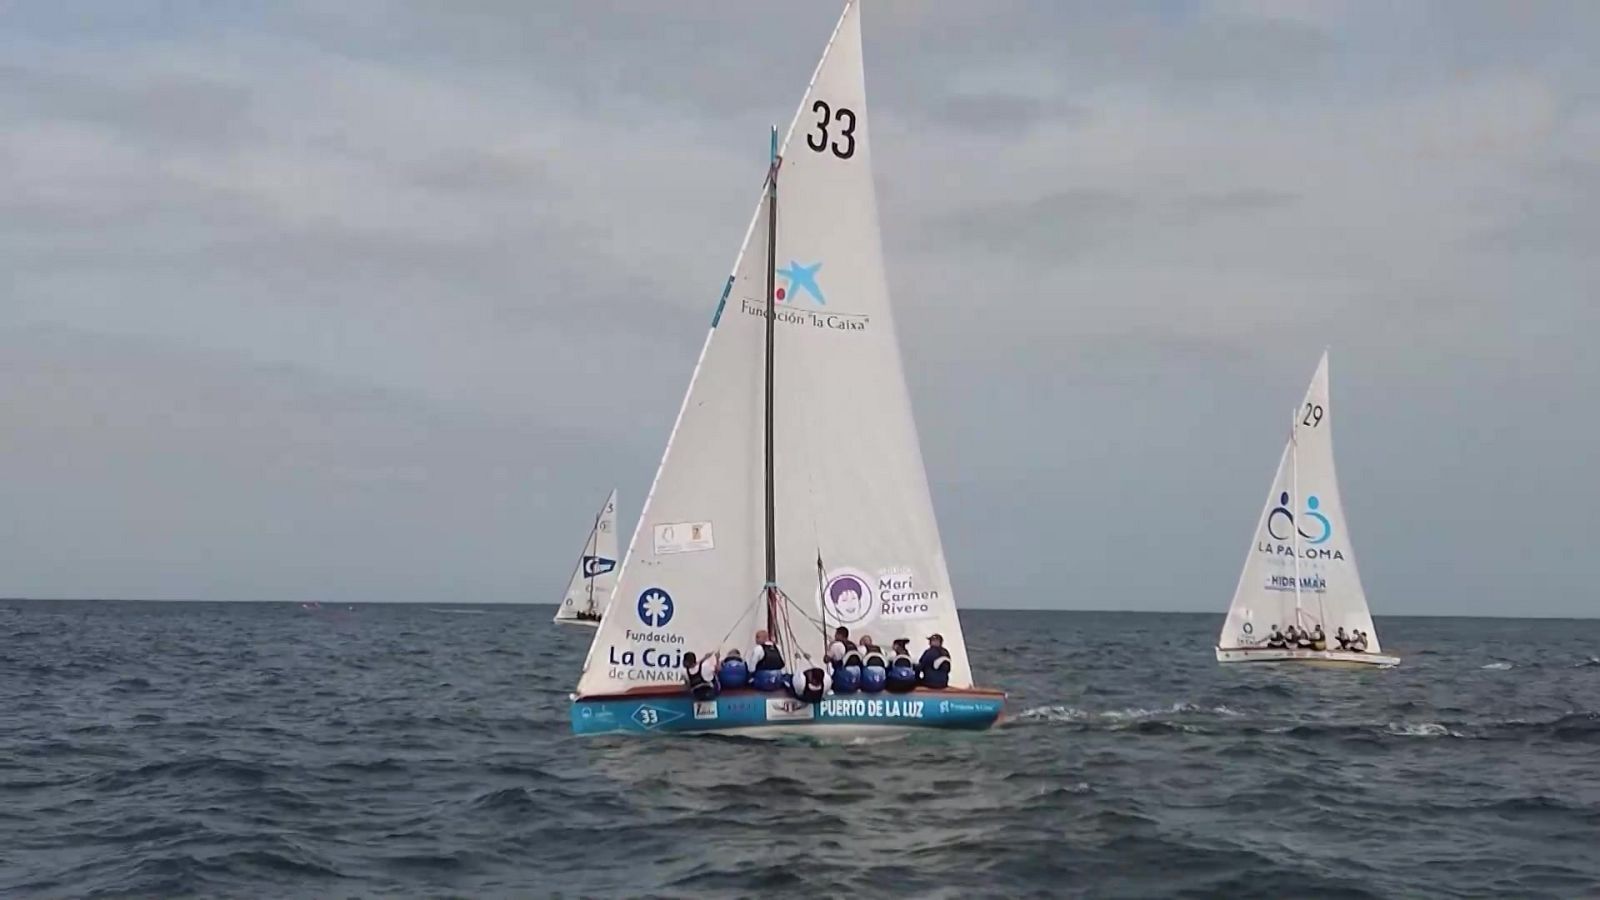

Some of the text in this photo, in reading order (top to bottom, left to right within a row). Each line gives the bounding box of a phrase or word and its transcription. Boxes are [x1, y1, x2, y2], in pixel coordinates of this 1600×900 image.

[807, 99, 856, 160] 33
[1303, 403, 1324, 428] 29
[1258, 541, 1345, 561] LA PALOMA
[879, 576, 913, 590] Mari
[880, 590, 939, 602] Carmen
[881, 602, 929, 615] Rivero
[625, 629, 685, 645] Fundación
[609, 646, 681, 669] La Caj
[608, 667, 687, 683] de CANARIA
[640, 709, 659, 724] 33
[819, 700, 863, 717] PUERTO
[867, 701, 883, 717] DE
[886, 701, 901, 717] LA
[902, 701, 924, 718] LUZ
